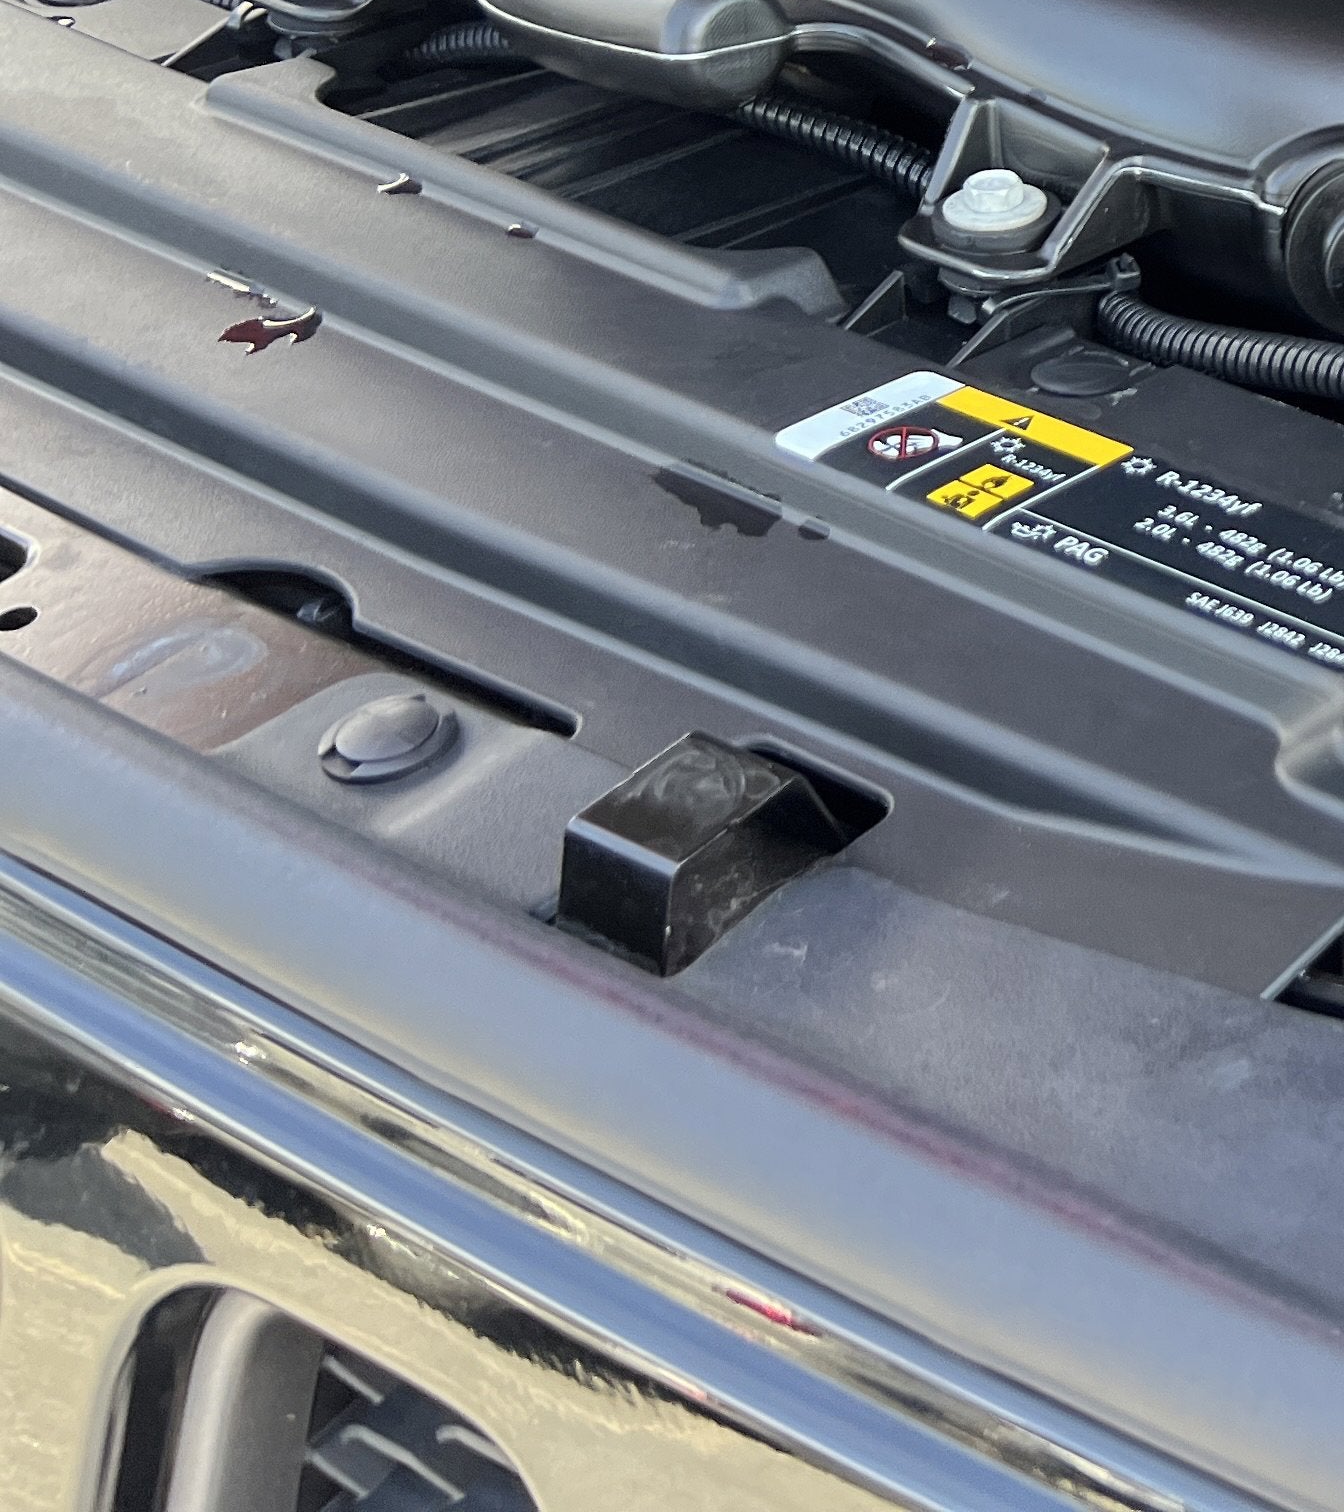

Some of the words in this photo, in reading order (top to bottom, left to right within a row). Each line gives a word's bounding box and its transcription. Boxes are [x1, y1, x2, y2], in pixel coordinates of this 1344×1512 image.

[1001, 453, 1067, 481] R-1234yf
[1155, 470, 1263, 518] R-1234yf
[1053, 535, 1110, 567] PAG
[1133, 517, 1177, 541] 2.0L
[1195, 541, 1245, 571] 482g
[1244, 560, 1301, 589] (1.06
[1157, 504, 1200, 529] 3.6L
[1218, 529, 1267, 557] 482g
[1266, 547, 1323, 574] (1.06
[1185, 591, 1220, 613] SAE
[1214, 603, 1254, 628] J639
[1256, 620, 1306, 650] J2842
